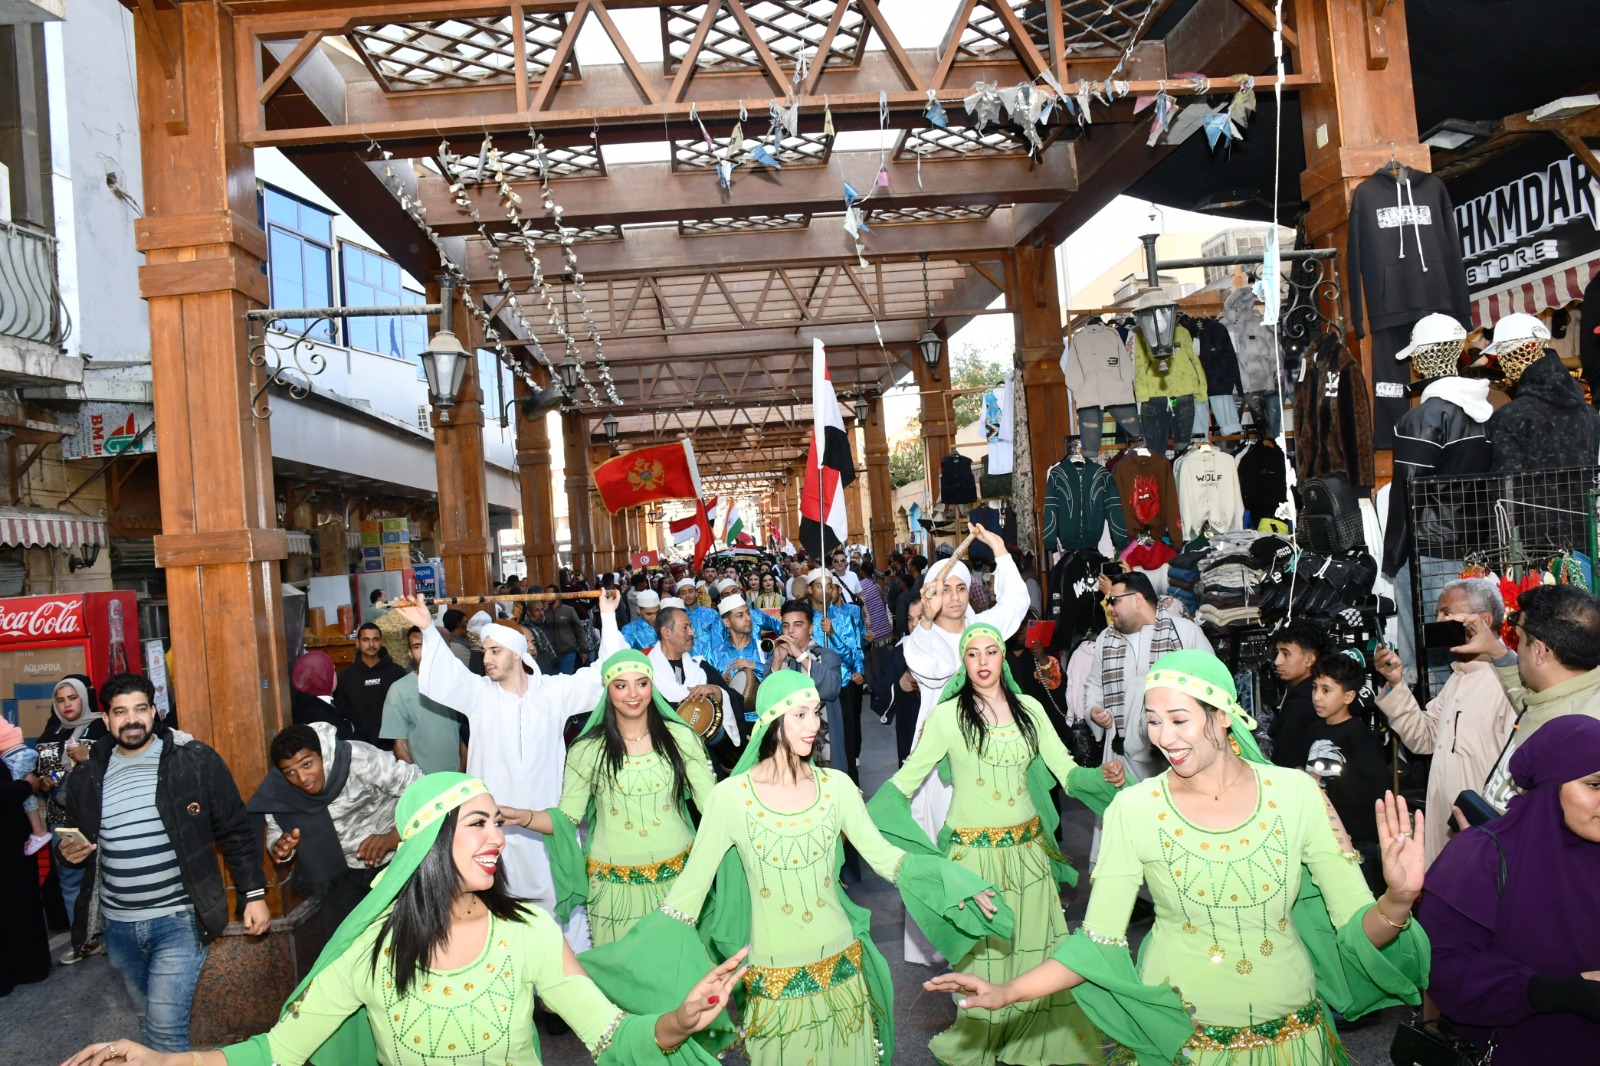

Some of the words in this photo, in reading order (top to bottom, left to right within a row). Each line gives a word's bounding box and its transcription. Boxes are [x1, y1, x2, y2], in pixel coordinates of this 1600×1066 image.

[1466, 240, 1558, 286] STORE
[91, 414, 104, 440] BM
[1195, 474, 1223, 482] WOLF
[414, 569, 431, 577] epsi
[0, 600, 83, 637] oca-Cola
[24, 663, 61, 674] AQUAFINA
